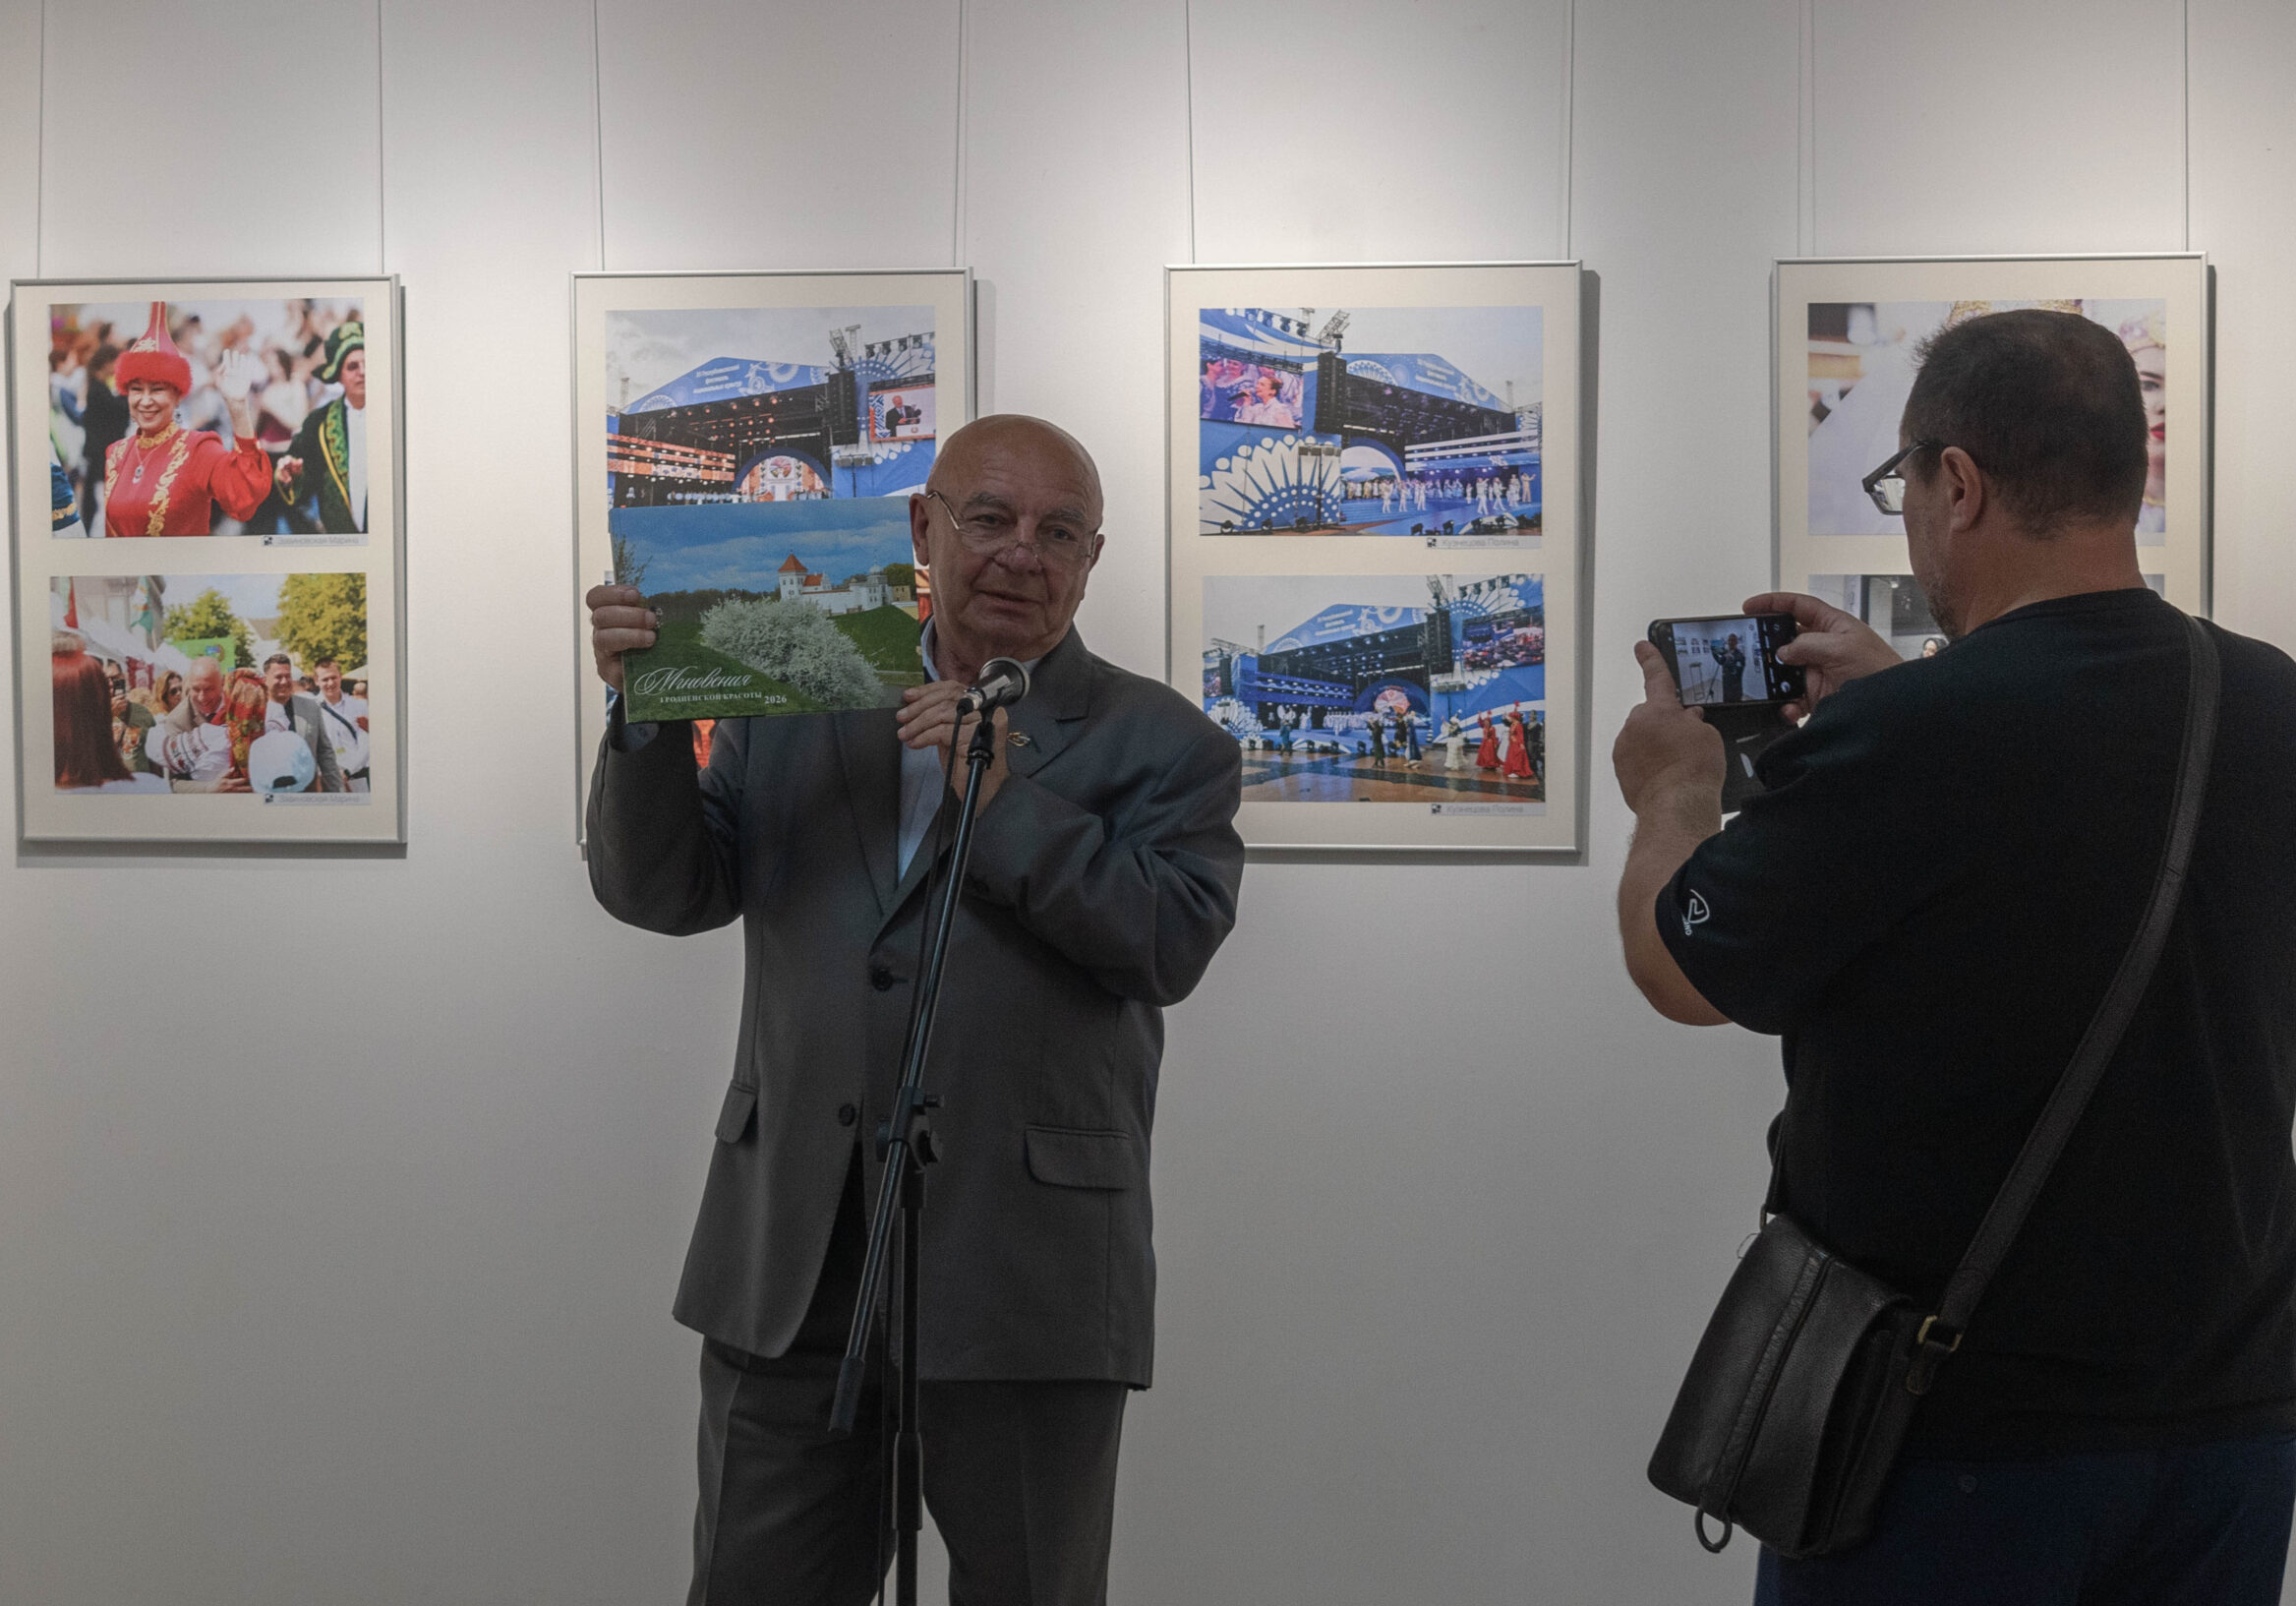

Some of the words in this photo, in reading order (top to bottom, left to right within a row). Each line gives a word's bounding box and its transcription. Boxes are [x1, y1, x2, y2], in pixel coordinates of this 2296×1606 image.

[634, 666, 753, 696] Мгновения
[660, 692, 721, 704] ГРОДНЕНСКОЙ
[723, 691, 762, 700] КРАСОТЫ
[764, 695, 788, 704] 2026
